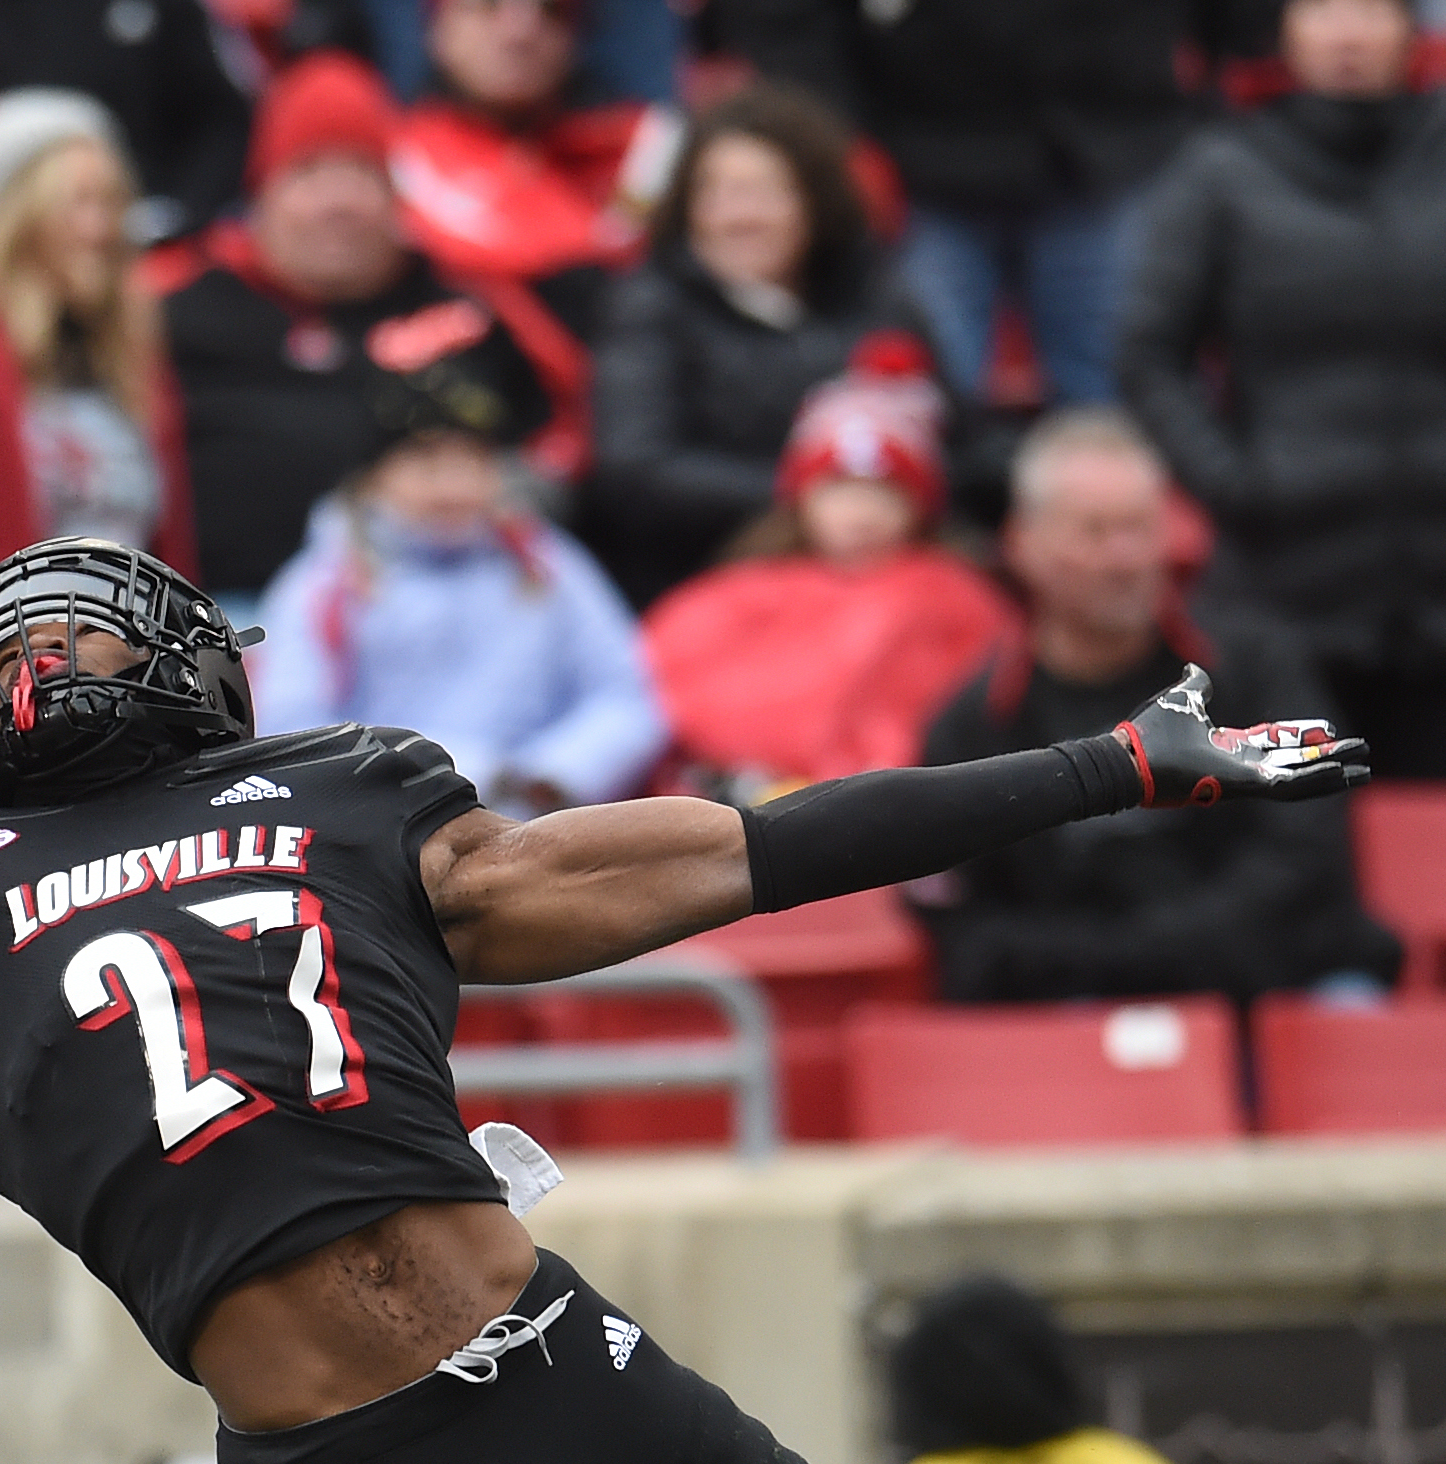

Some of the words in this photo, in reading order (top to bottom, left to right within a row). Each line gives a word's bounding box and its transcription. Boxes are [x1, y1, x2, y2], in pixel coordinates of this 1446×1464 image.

[210, 784, 293, 807] adidas
[4, 825, 317, 954] LOUISVILLE
[58, 880, 370, 1166] 27
[612, 1323, 642, 1371] adidas
